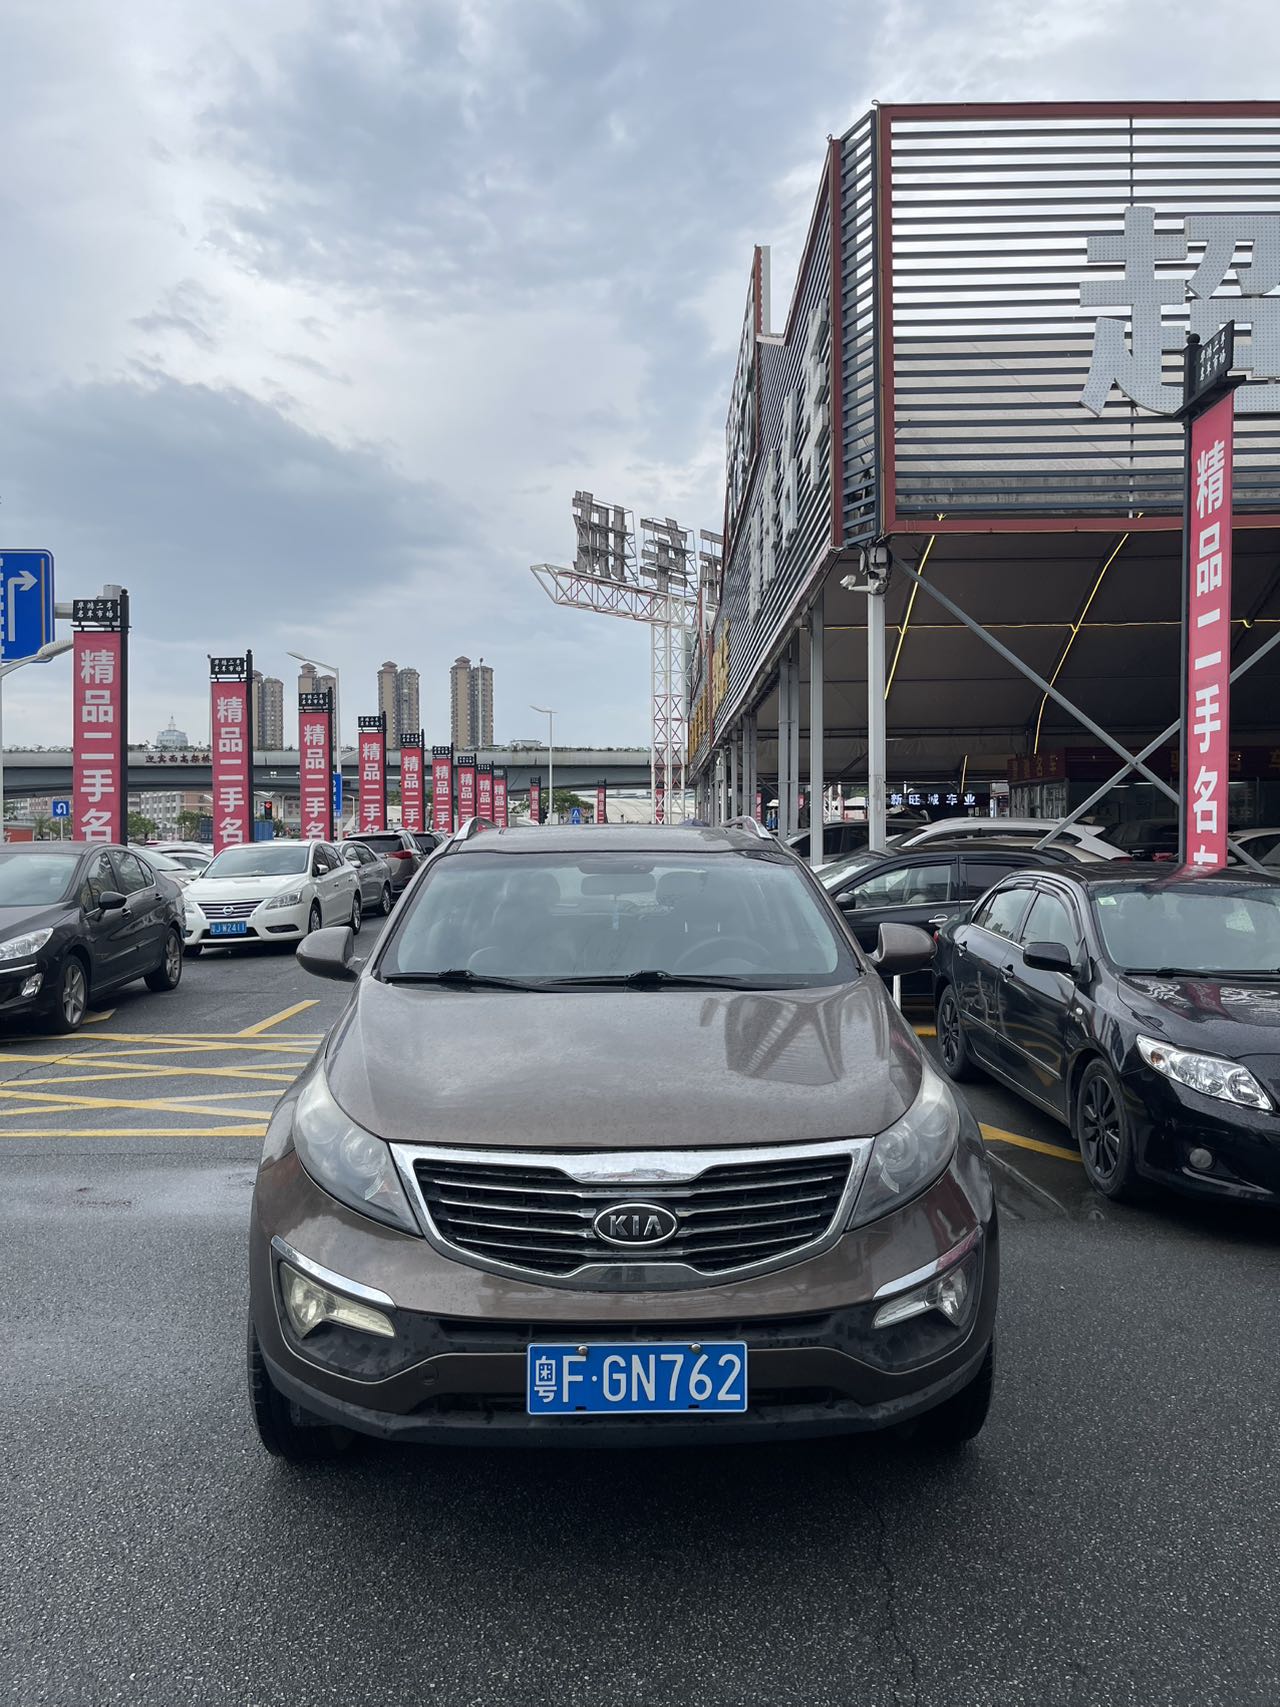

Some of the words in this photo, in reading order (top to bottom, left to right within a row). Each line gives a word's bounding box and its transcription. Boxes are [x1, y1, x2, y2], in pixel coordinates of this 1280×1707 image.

[217, 697, 244, 843] 精品二手名
[609, 1215, 664, 1236] KIA
